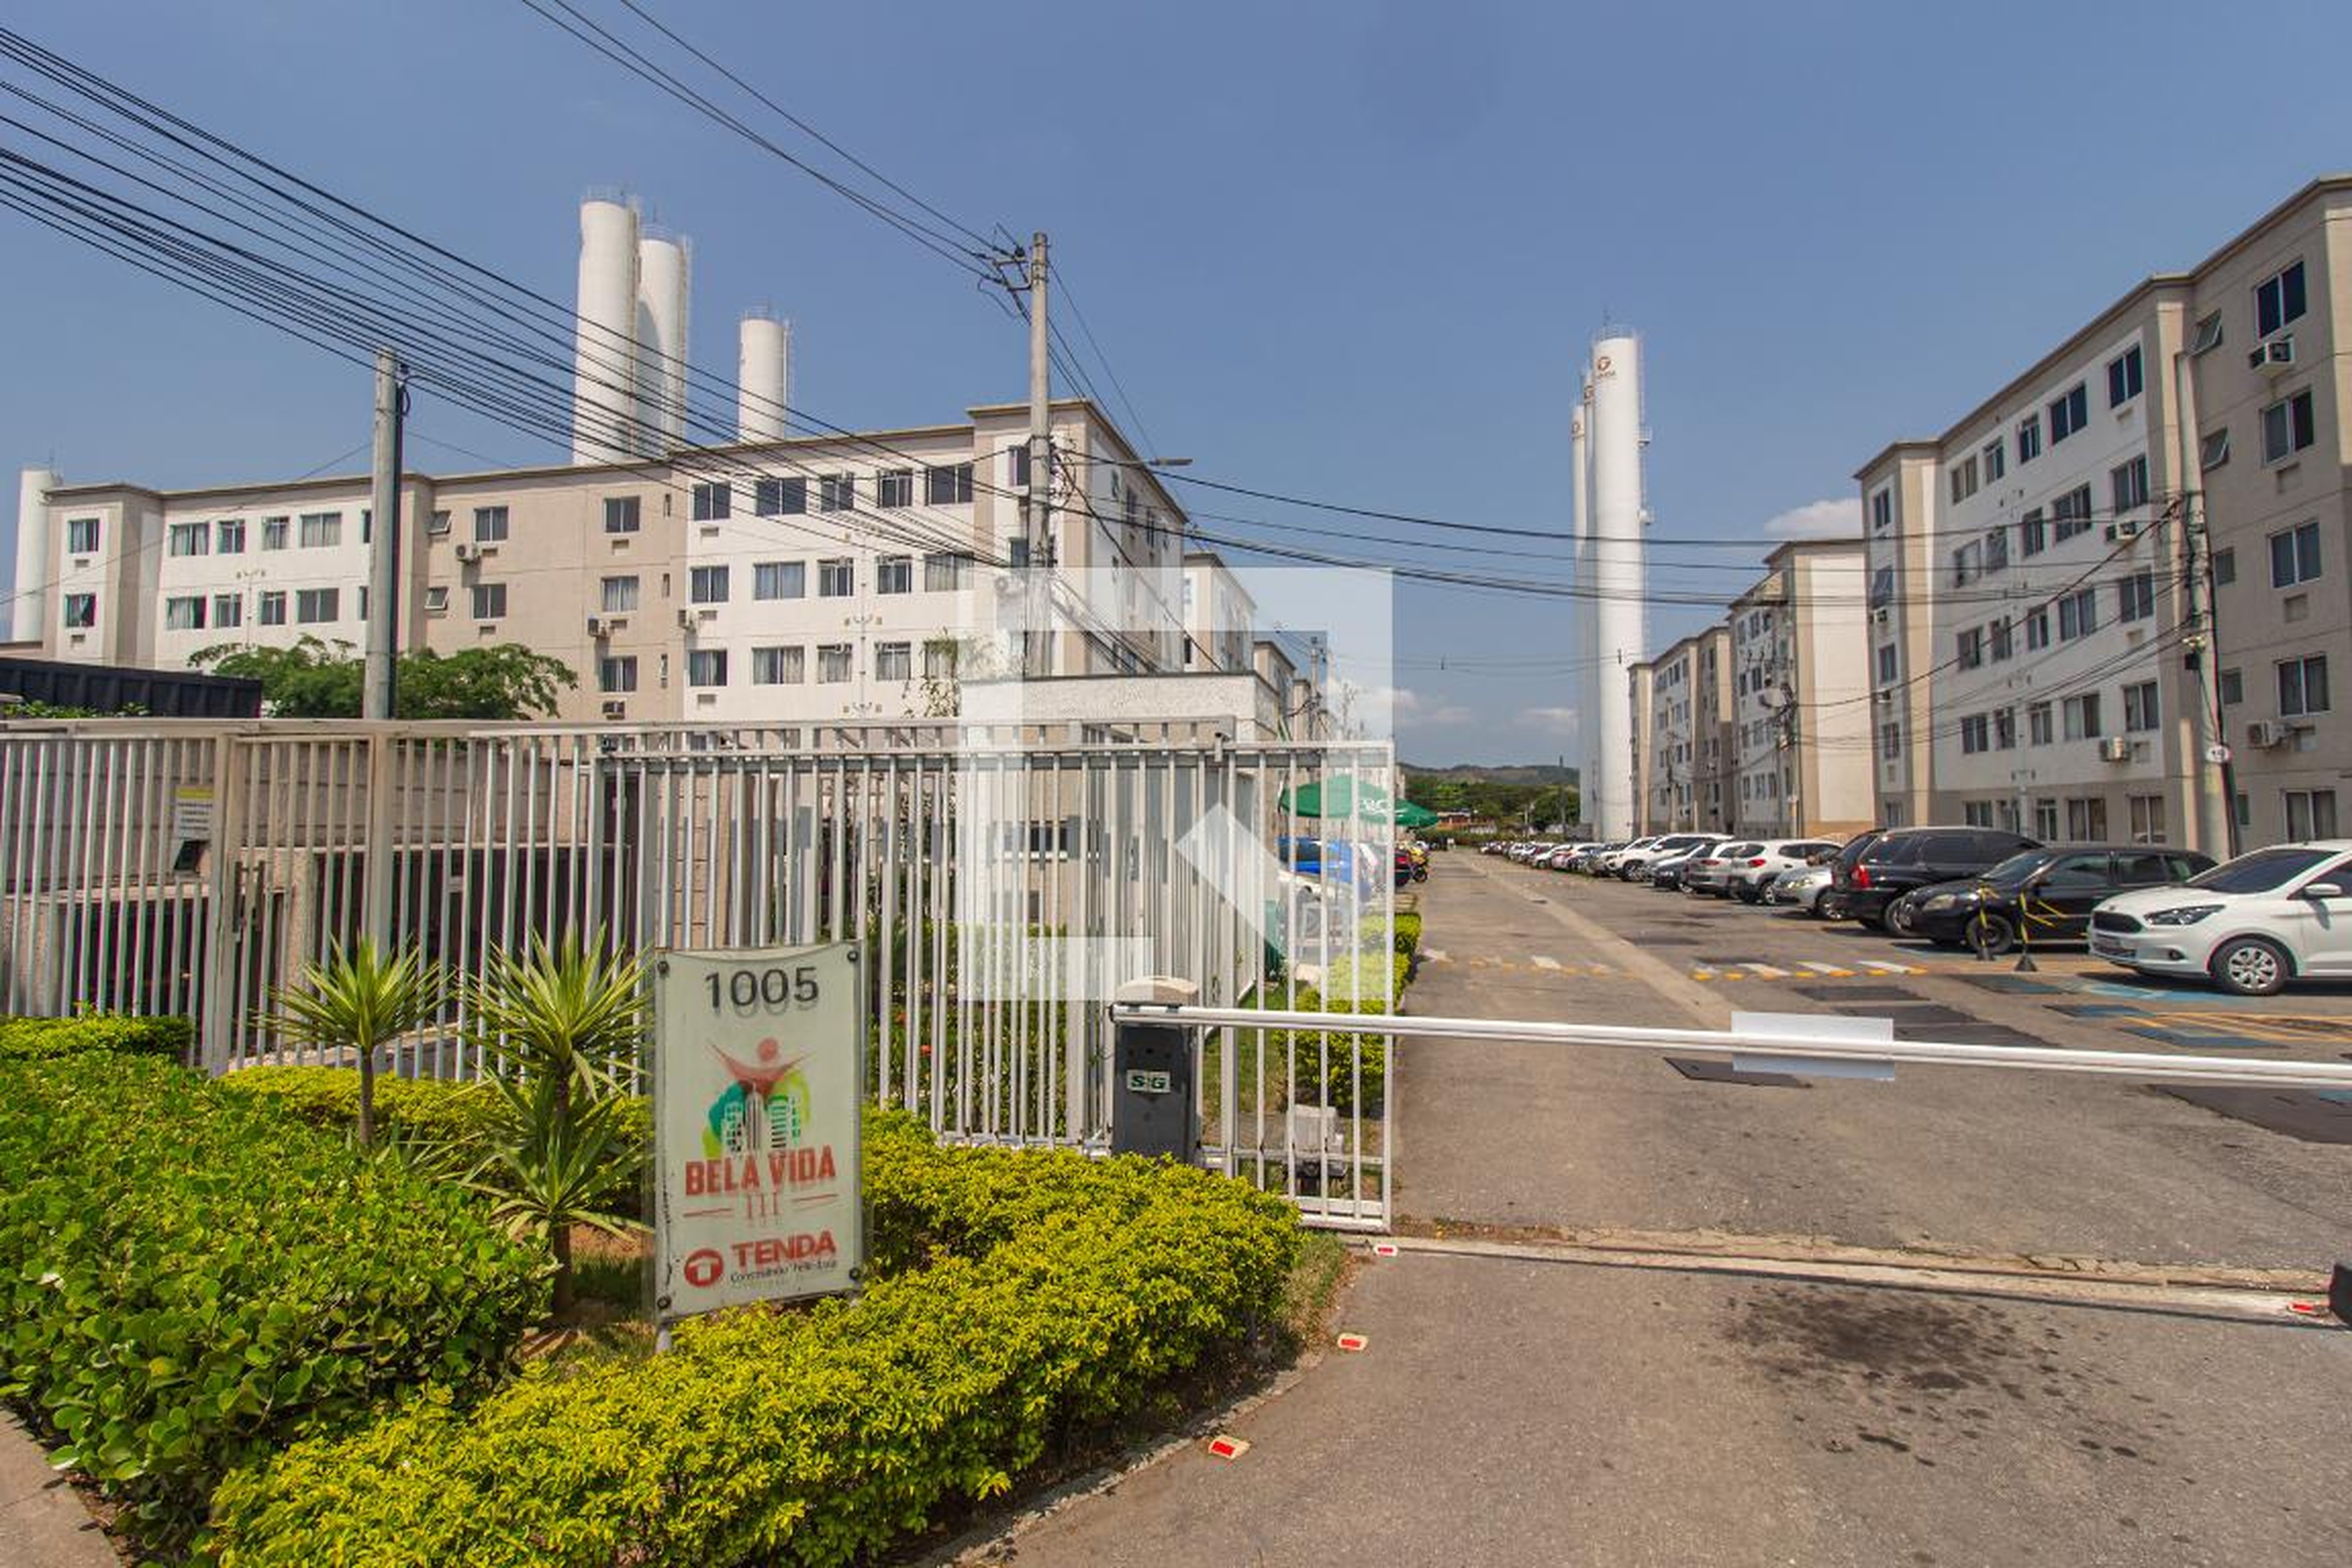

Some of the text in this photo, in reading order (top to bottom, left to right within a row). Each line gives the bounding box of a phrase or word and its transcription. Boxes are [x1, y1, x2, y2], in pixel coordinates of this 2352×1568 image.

[705, 966, 819, 1009] 1005
[685, 1144, 836, 1196] BELA VIDA
[731, 1229, 837, 1267] TENDA
